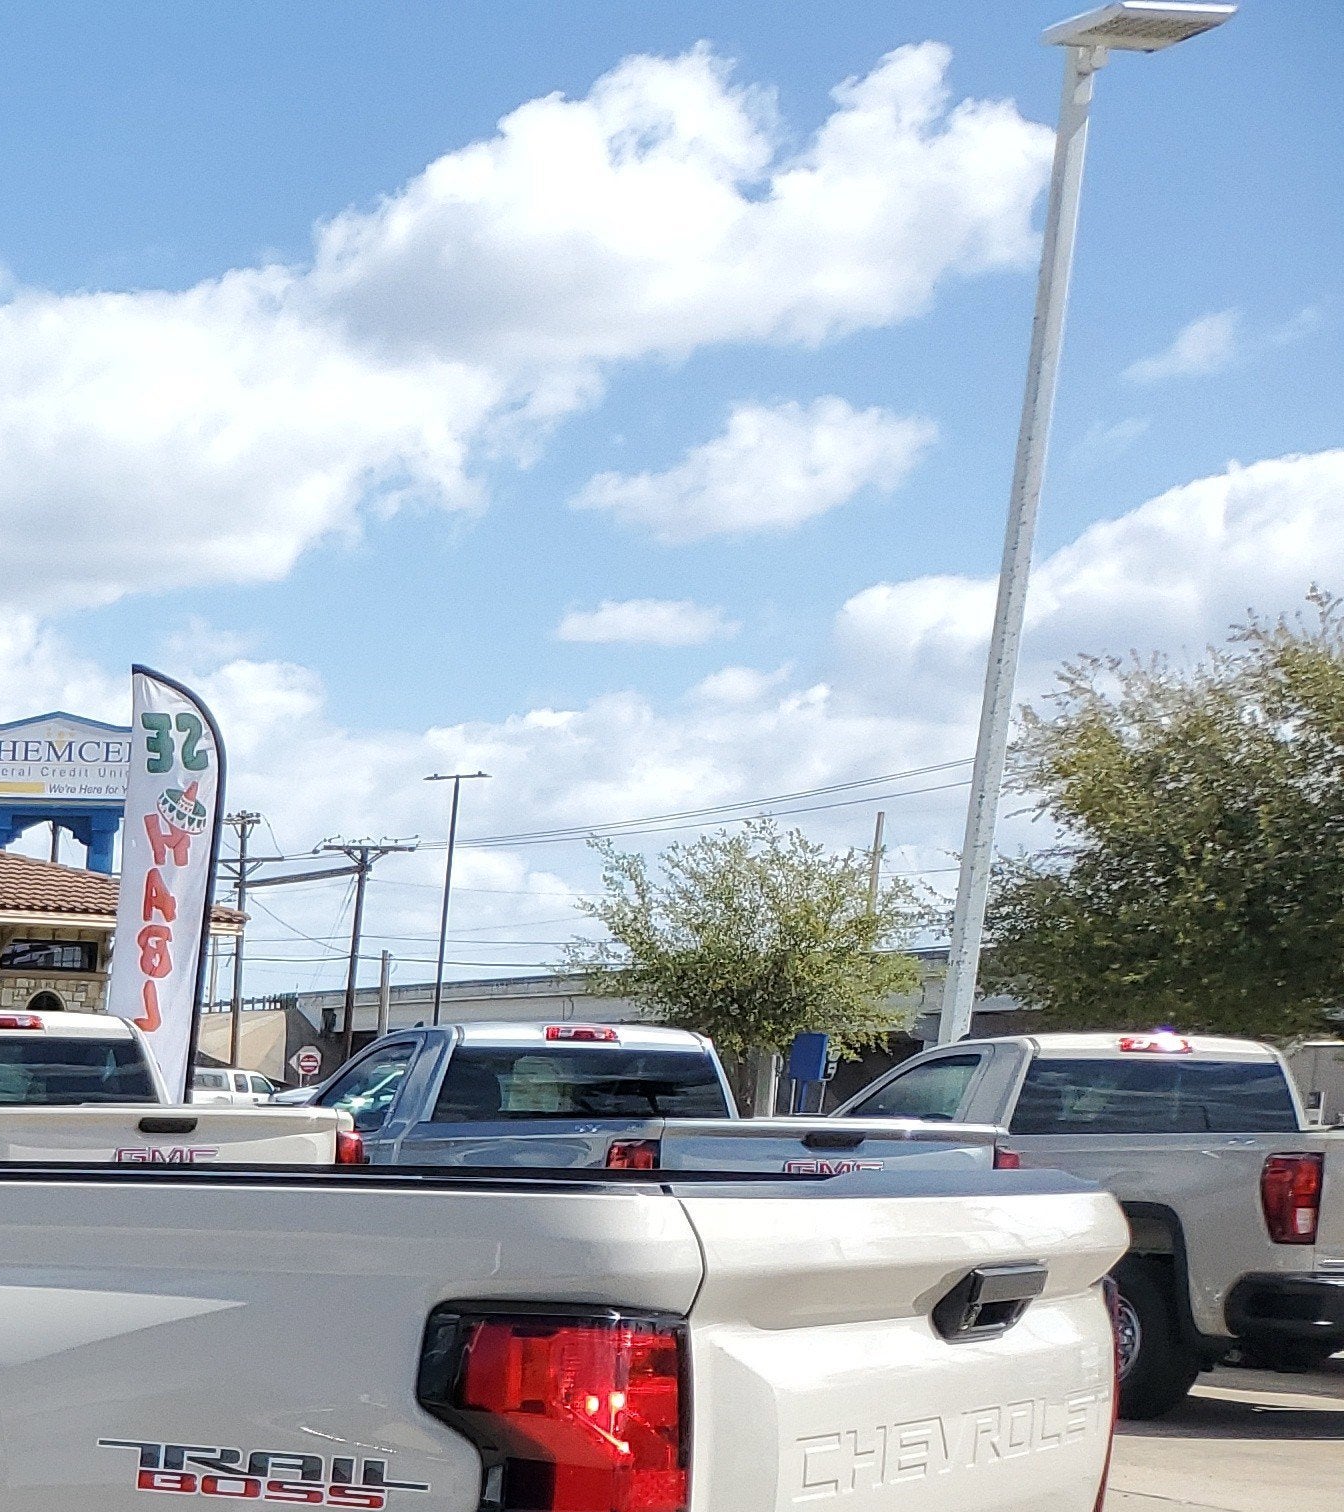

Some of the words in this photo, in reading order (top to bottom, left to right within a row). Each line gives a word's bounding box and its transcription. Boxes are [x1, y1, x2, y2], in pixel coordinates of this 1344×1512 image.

[40, 766, 89, 778] Credit
[49, 784, 77, 794] We're
[79, 785, 102, 794] Here
[105, 785, 118, 794] for
[97, 1438, 431, 1492] TRAIL
[135, 1468, 389, 1511] BOSS
